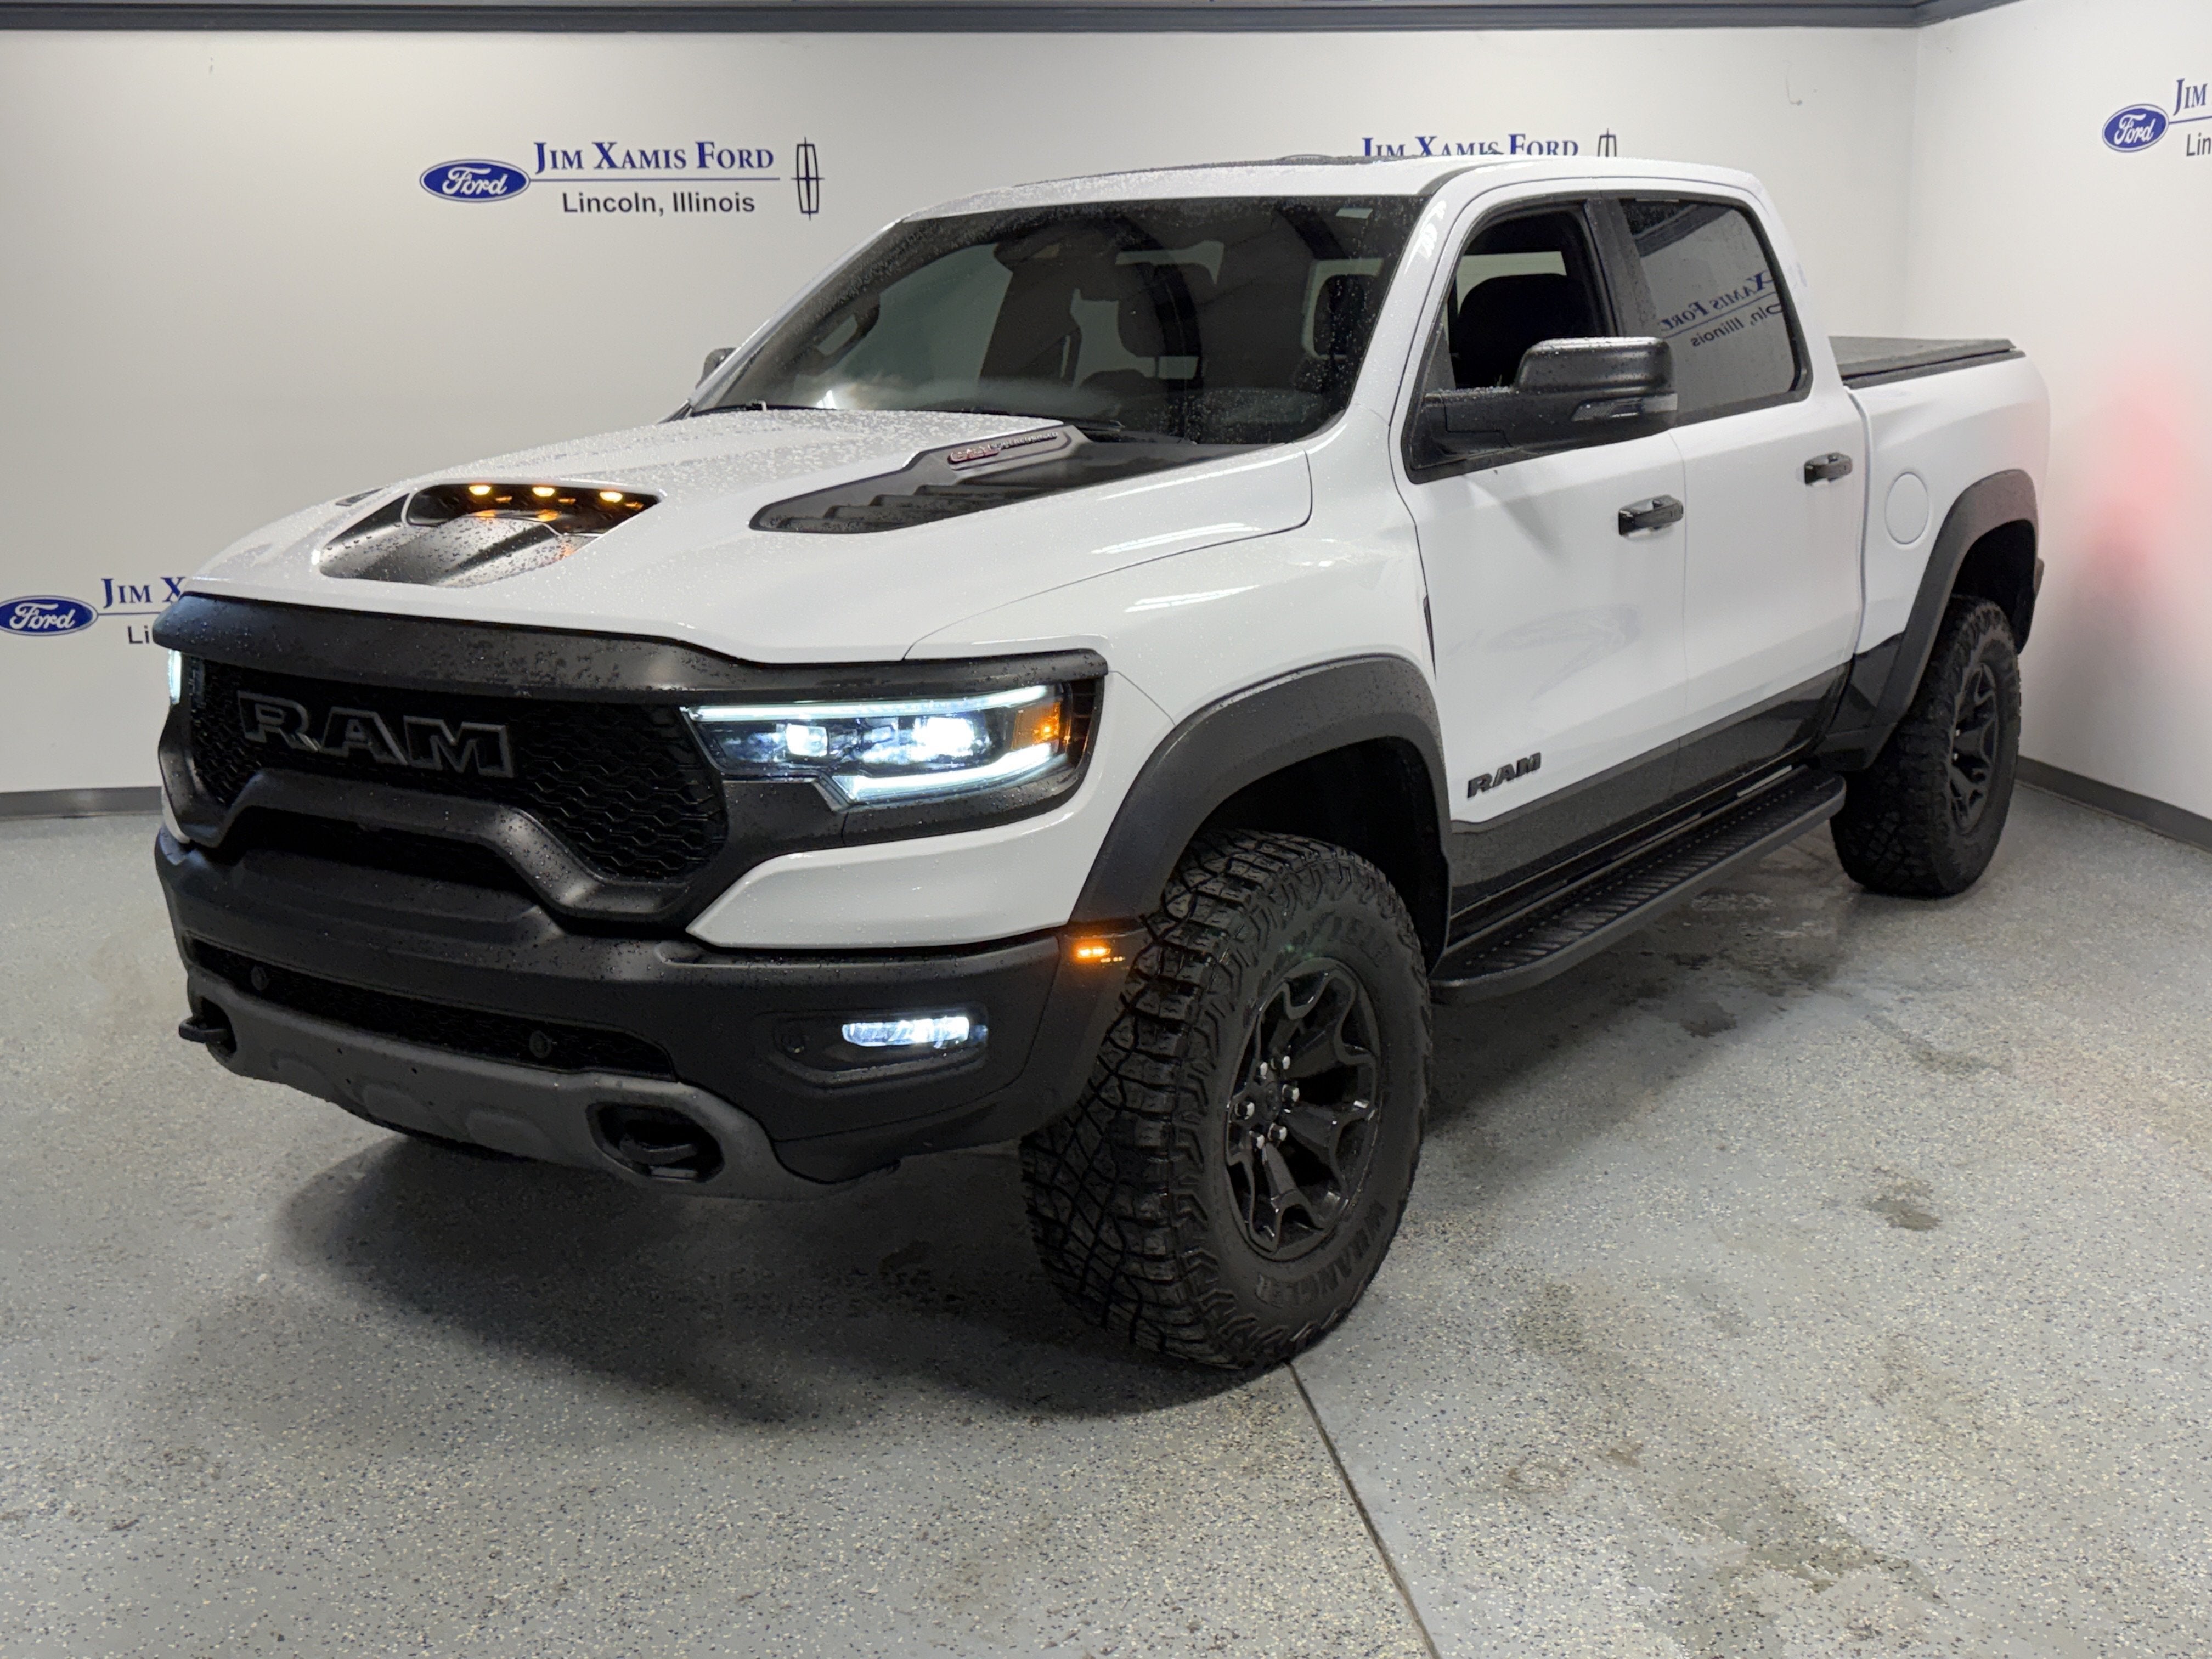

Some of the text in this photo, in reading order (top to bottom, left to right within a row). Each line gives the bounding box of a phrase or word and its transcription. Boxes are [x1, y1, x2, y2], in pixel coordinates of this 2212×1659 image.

[2173, 78, 2208, 116] JIM
[1508, 133, 1579, 156] FORD
[2114, 113, 2156, 145] Ford
[533, 142, 774, 174] JIM XAMIS FORD
[442, 166, 508, 196] Ford
[562, 192, 755, 217] Lincoln, Illinois
[101, 578, 153, 608] JIM
[9, 603, 76, 629] Ford
[238, 690, 515, 778] RAM
[1467, 752, 1542, 798] RAM
